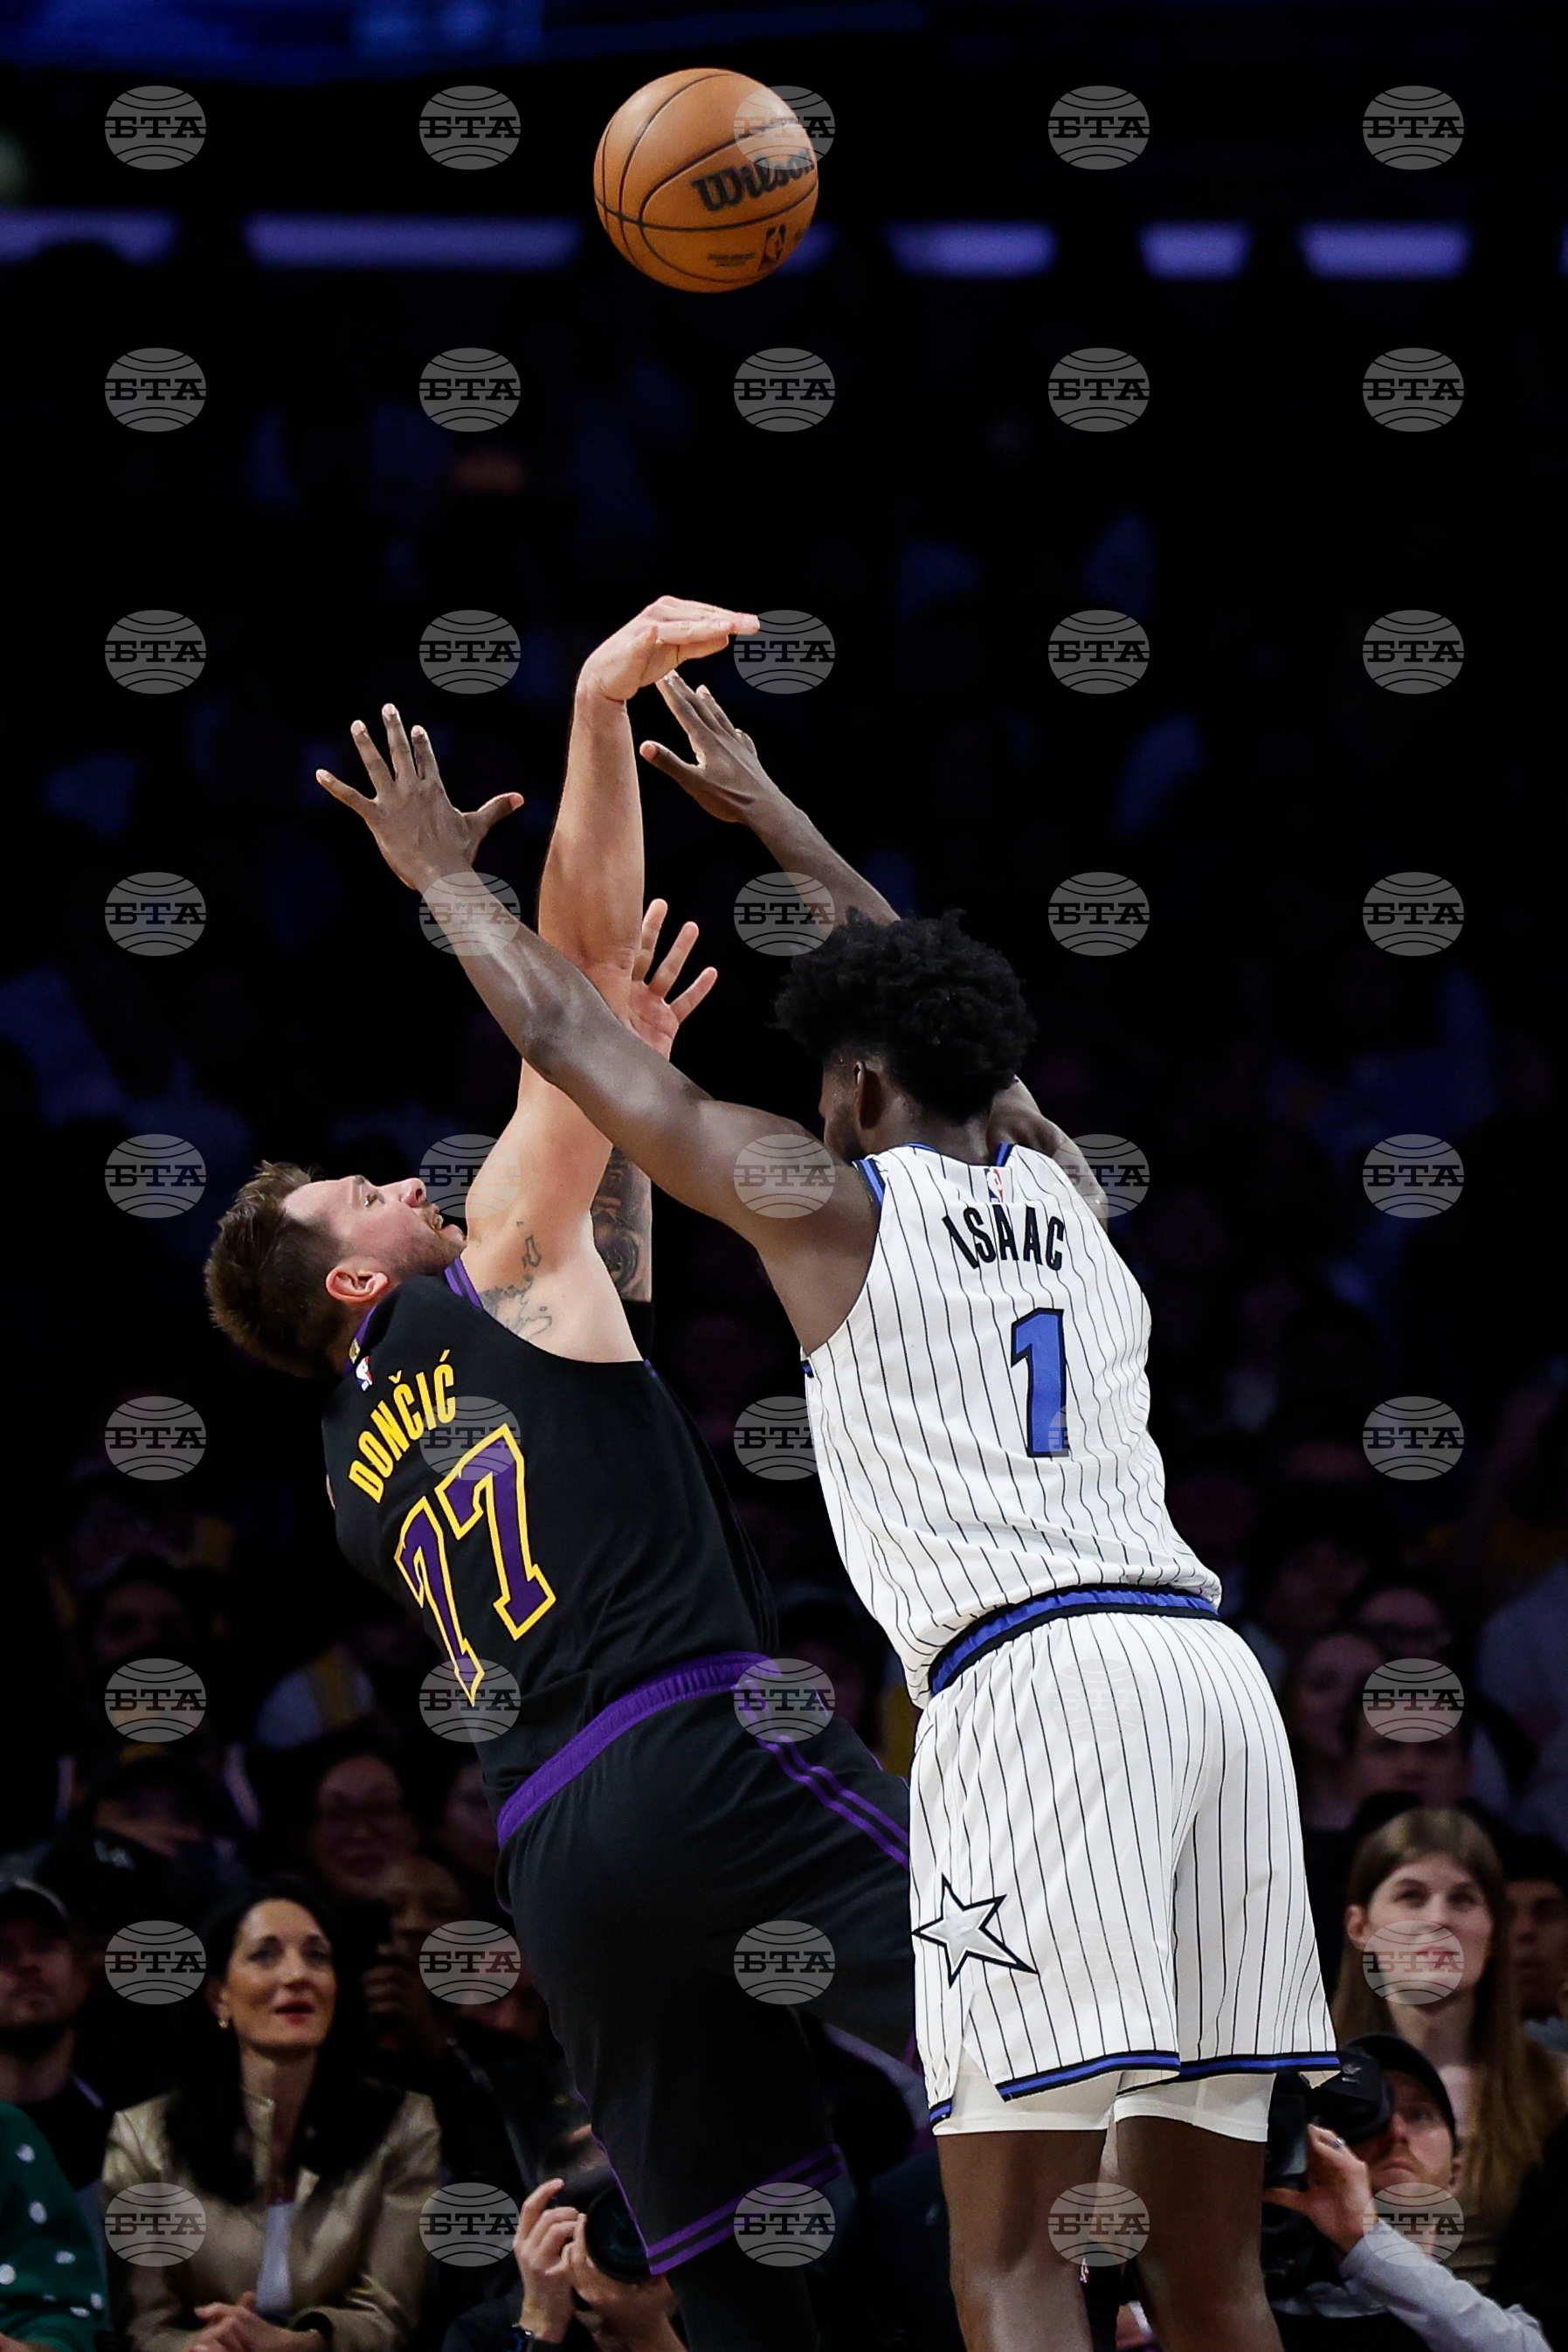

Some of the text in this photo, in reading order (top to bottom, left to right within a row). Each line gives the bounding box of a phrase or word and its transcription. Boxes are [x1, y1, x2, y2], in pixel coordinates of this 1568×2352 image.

[691, 149, 815, 211] Wilson
[943, 1204, 1065, 1271] ISAAC
[348, 1349, 456, 1504] DONČIĆ
[1011, 1307, 1069, 1457] 1
[394, 1422, 556, 1707] 77
